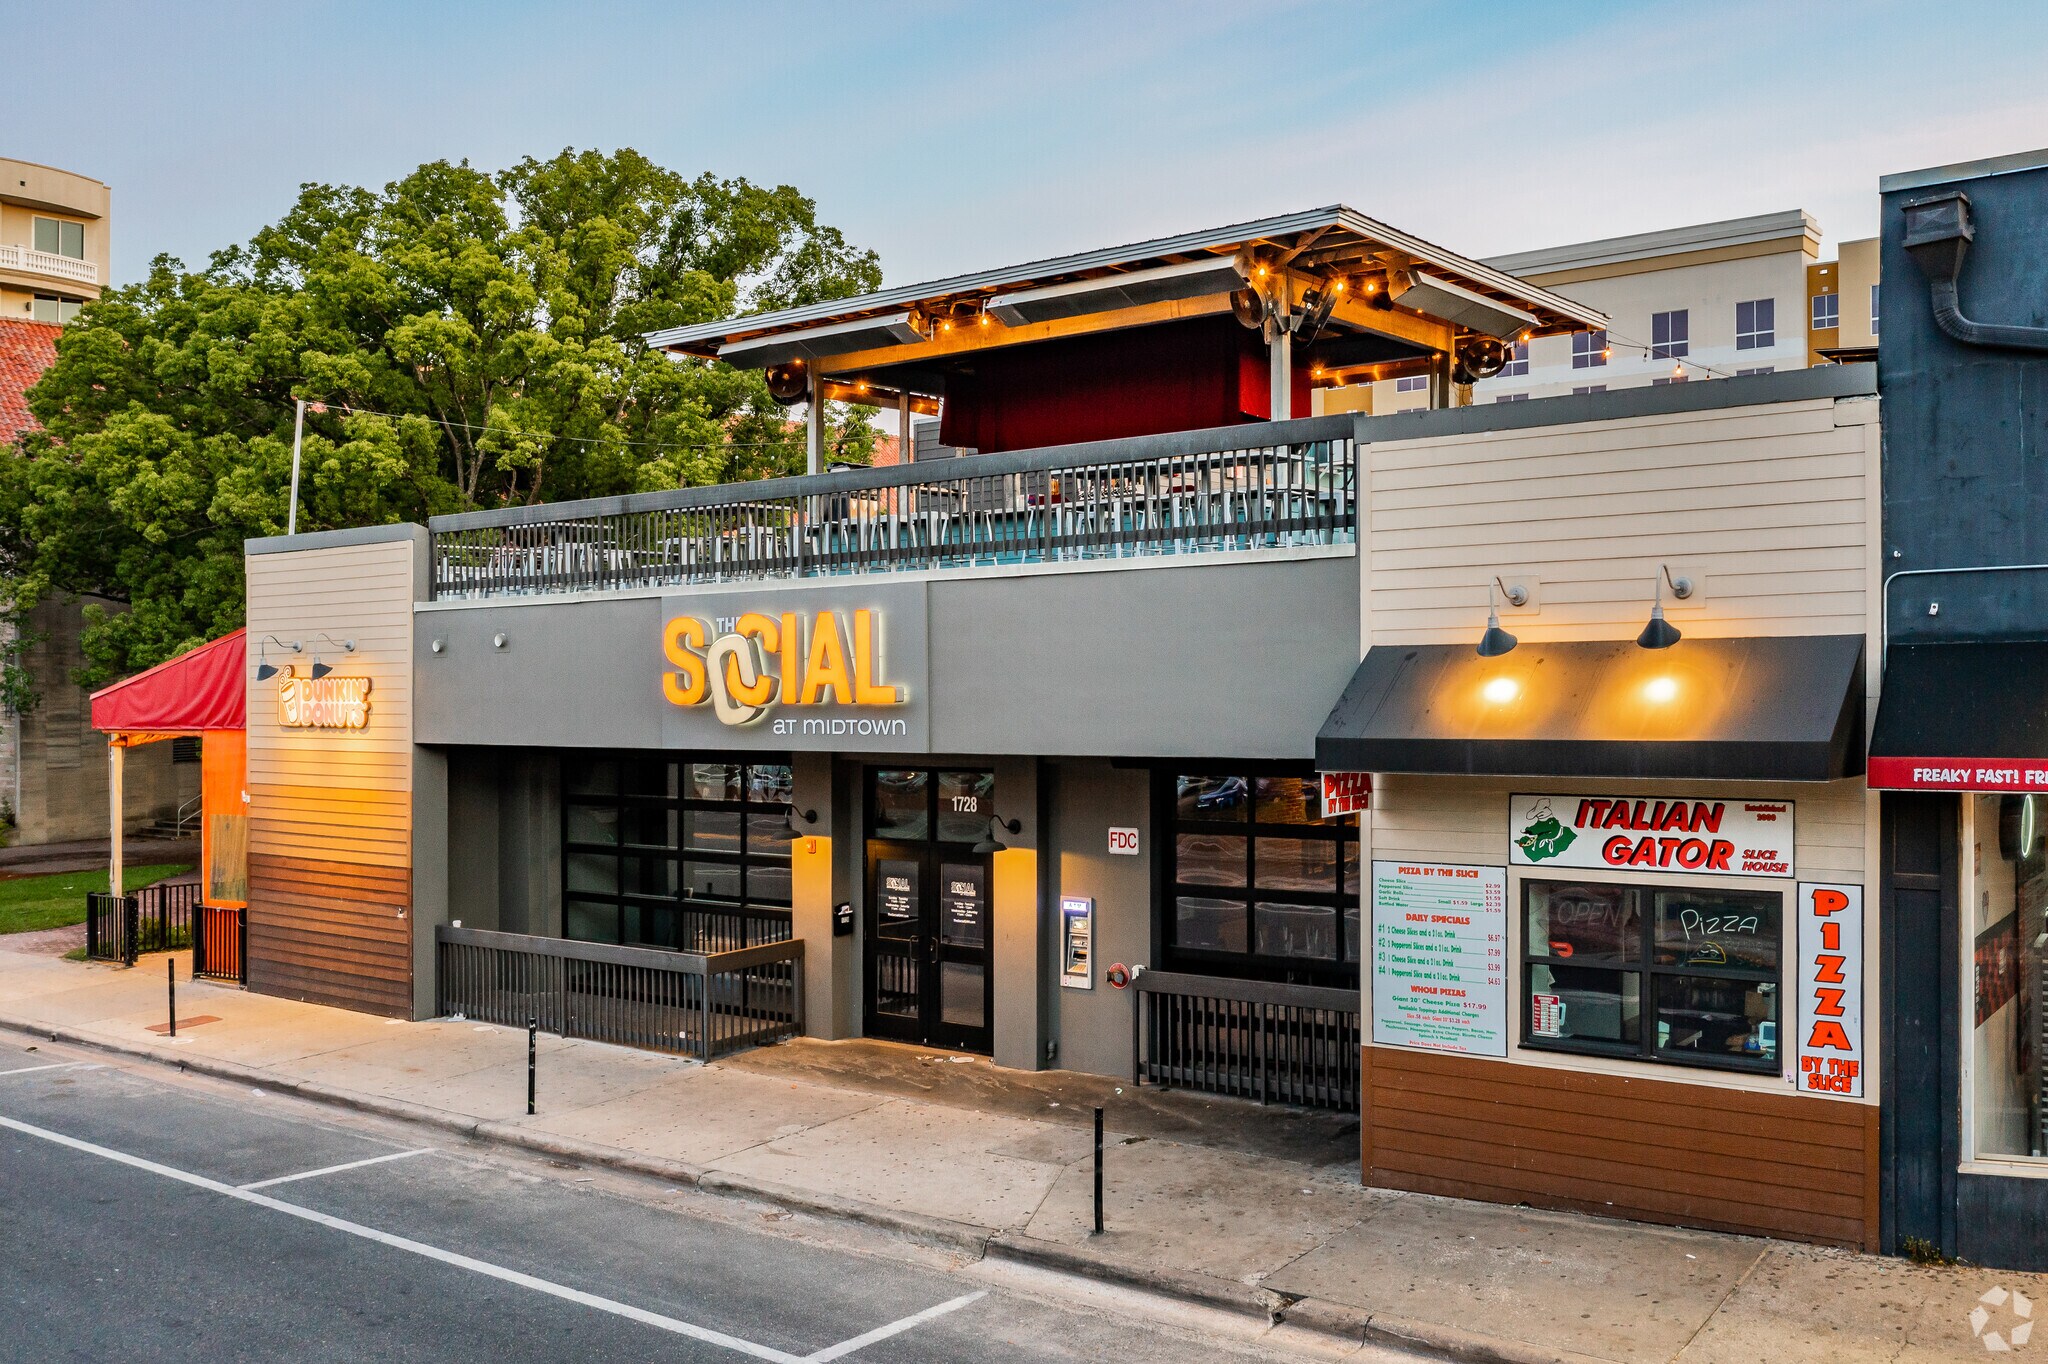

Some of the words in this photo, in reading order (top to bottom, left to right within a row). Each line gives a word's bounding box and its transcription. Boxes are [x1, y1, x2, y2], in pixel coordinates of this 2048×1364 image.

[663, 609, 904, 725] SOCIAL
[301, 703, 366, 727] DONUTS
[1913, 768, 1971, 783] FREAKY
[1976, 769, 2019, 784] FAST!
[1324, 773, 1373, 799] PIZZA
[952, 796, 977, 812] 1728
[1574, 799, 1725, 833] ITALIAN
[1109, 831, 1137, 849] FDC
[1602, 835, 1735, 870] GATOR
[1742, 849, 1777, 861] SLICE
[1398, 867, 1421, 875] PIZZA
[1424, 868, 1434, 876] BY
[1437, 869, 1453, 877] THE
[1456, 870, 1478, 878] SLICE
[1742, 861, 1789, 873] HOUSE
[1406, 913, 1428, 922] DAILY
[1431, 914, 1470, 925] SPECIALS
[1558, 901, 1622, 927] OPEN
[1379, 924, 1384, 933] #1
[1392, 926, 1405, 934] Cheese
[1407, 927, 1418, 935] Slices
[1445, 930, 1455, 938] Drink
[1379, 938, 1385, 947] #2
[1392, 940, 1412, 950] Pepperoni
[1413, 942, 1424, 950] Slices
[1451, 945, 1461, 953] Drink
[1379, 952, 1385, 961] #3
[1392, 954, 1405, 963] Cheese
[1443, 959, 1453, 967] Drink
[1379, 965, 1385, 974] #4
[1392, 968, 1412, 977] Pepperoni
[1449, 973, 1460, 981] Drink
[1808, 889, 1853, 1051] PIZZA
[1411, 985, 1437, 994] WHOLE
[1440, 988, 1466, 997] PIZZAS
[1422, 998, 1443, 1006] Cheese
[1463, 1002, 1486, 1010] $17.99
[1801, 1055, 1824, 1073] BY
[1827, 1058, 1859, 1077] THE
[1808, 1073, 1852, 1093] SLICE
